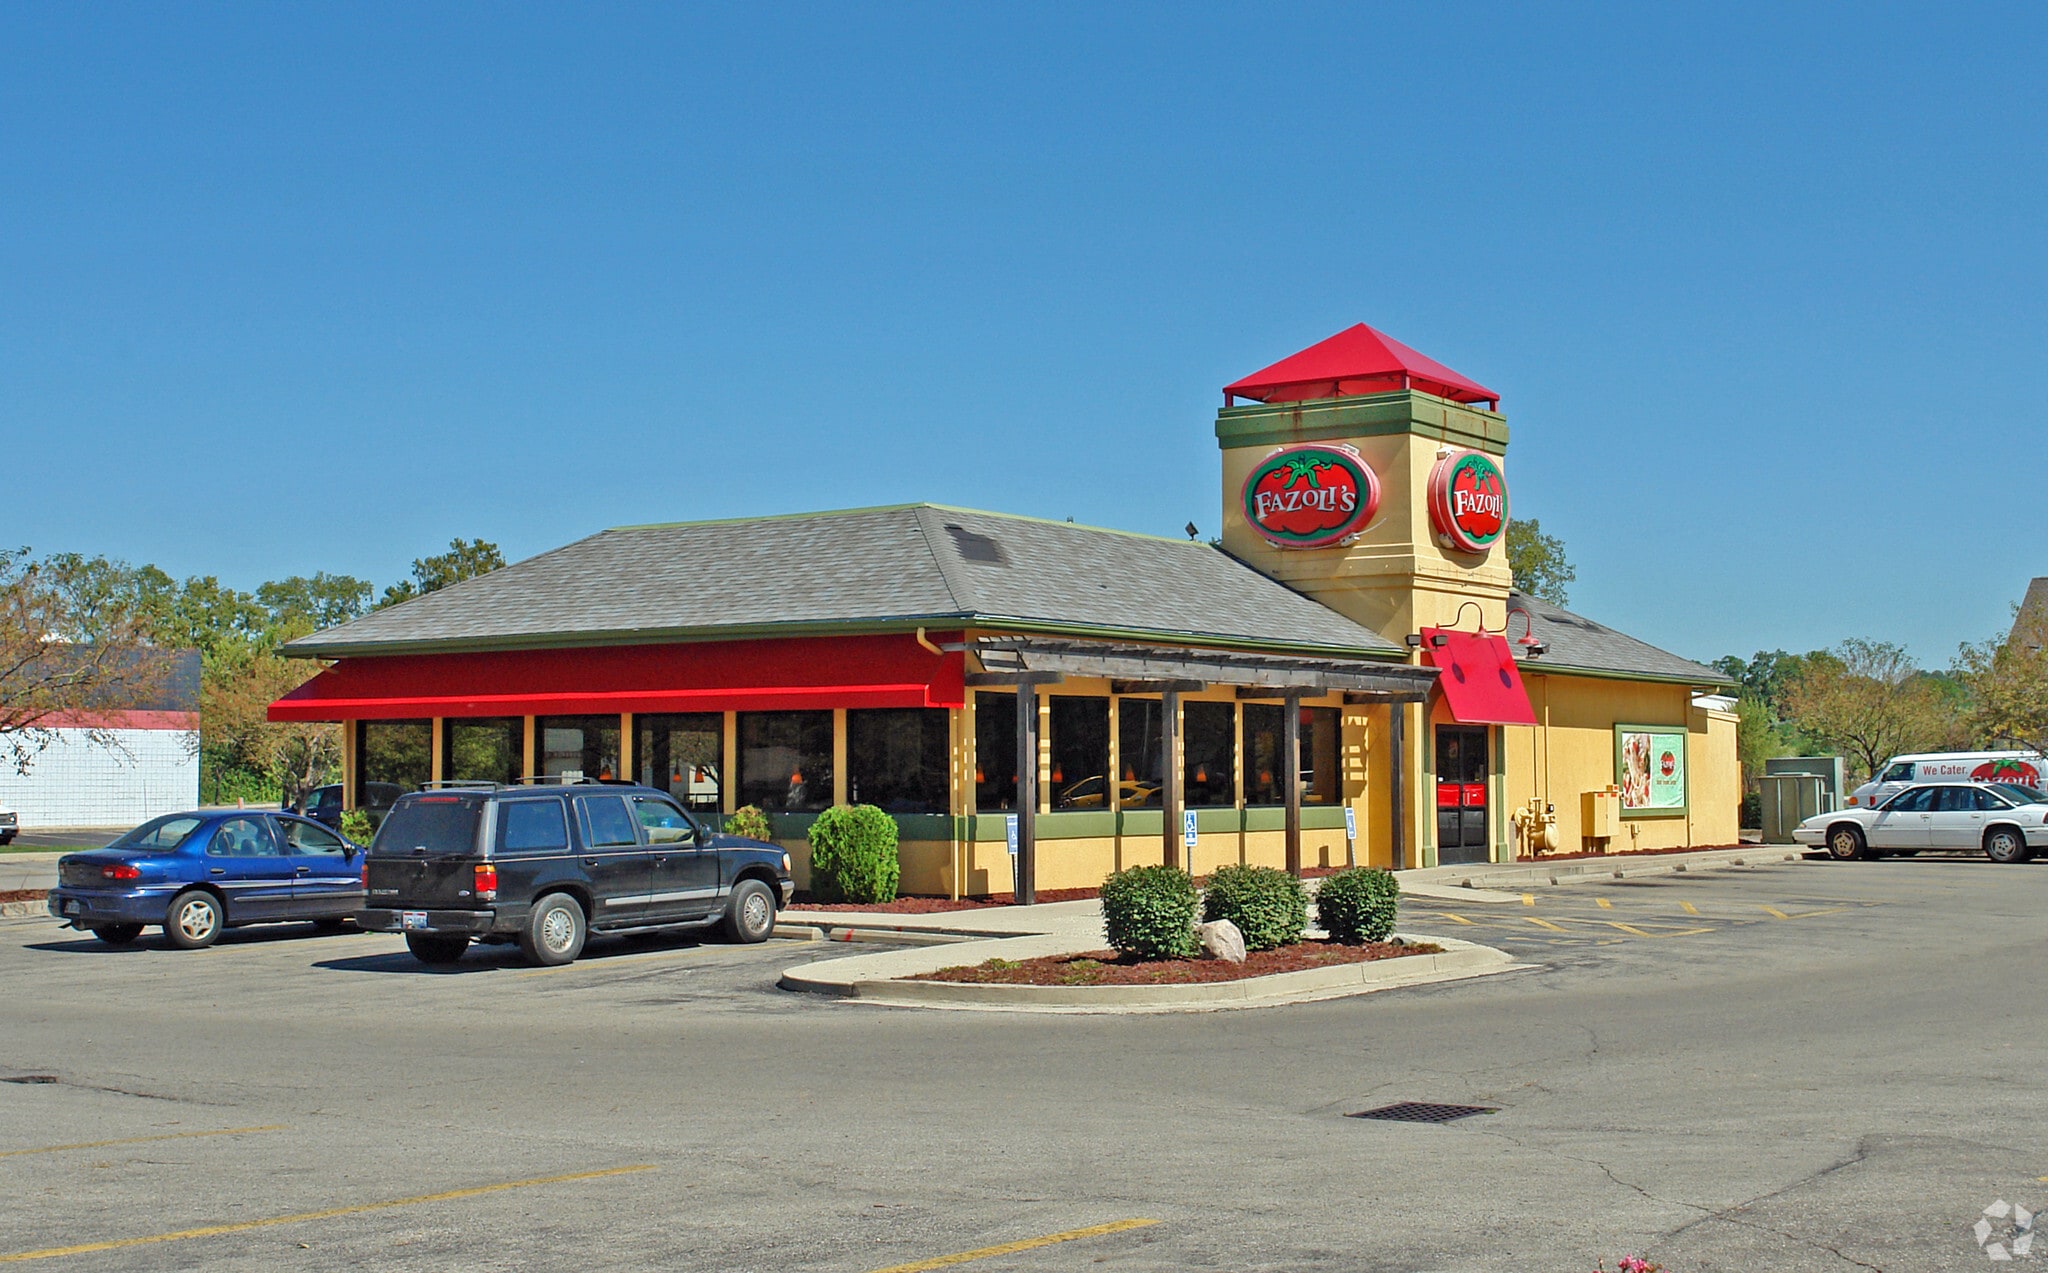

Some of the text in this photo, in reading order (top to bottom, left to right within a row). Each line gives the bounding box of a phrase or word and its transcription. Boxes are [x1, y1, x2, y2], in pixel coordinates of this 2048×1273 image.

[1254, 485, 1356, 519] FAZOLI'S
[1922, 764, 1968, 776] We Cater.
